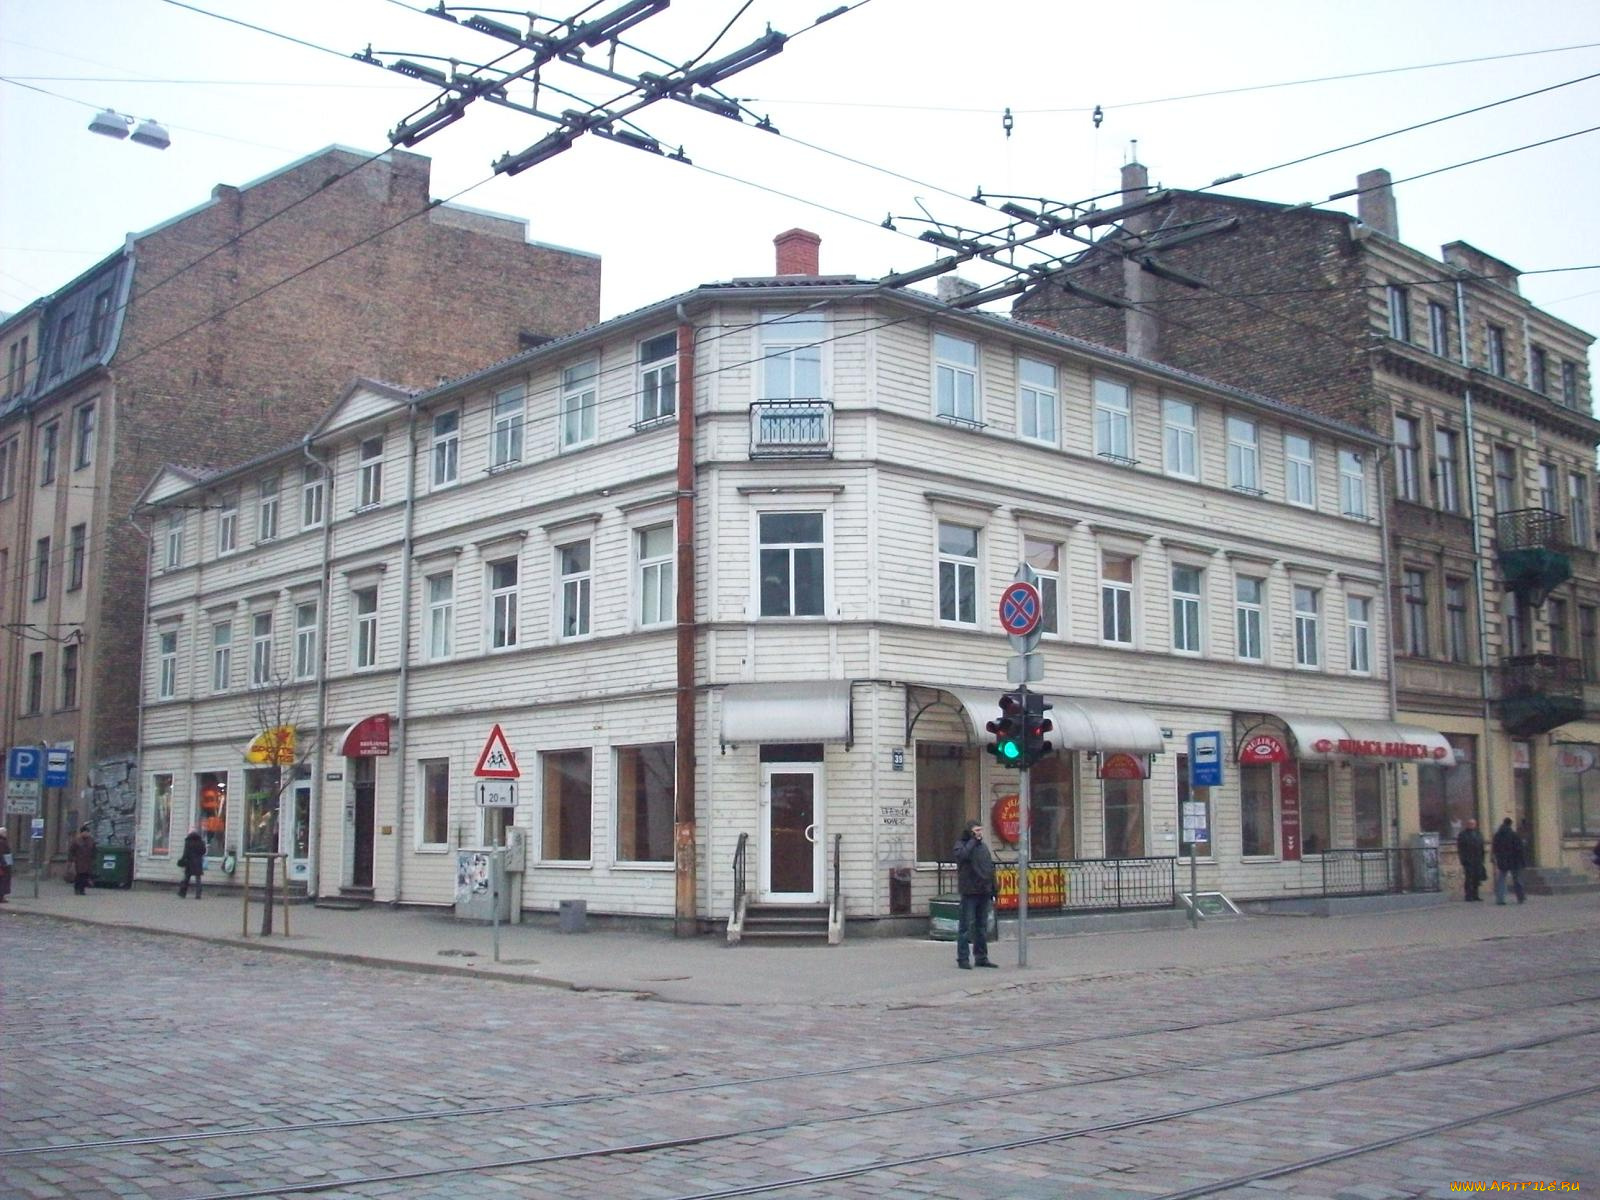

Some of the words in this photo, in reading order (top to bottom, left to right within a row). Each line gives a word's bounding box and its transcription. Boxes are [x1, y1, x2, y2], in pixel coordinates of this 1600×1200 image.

[15, 752, 34, 775] P
[894, 754, 903, 764] 39
[489, 793, 499, 802] 20
